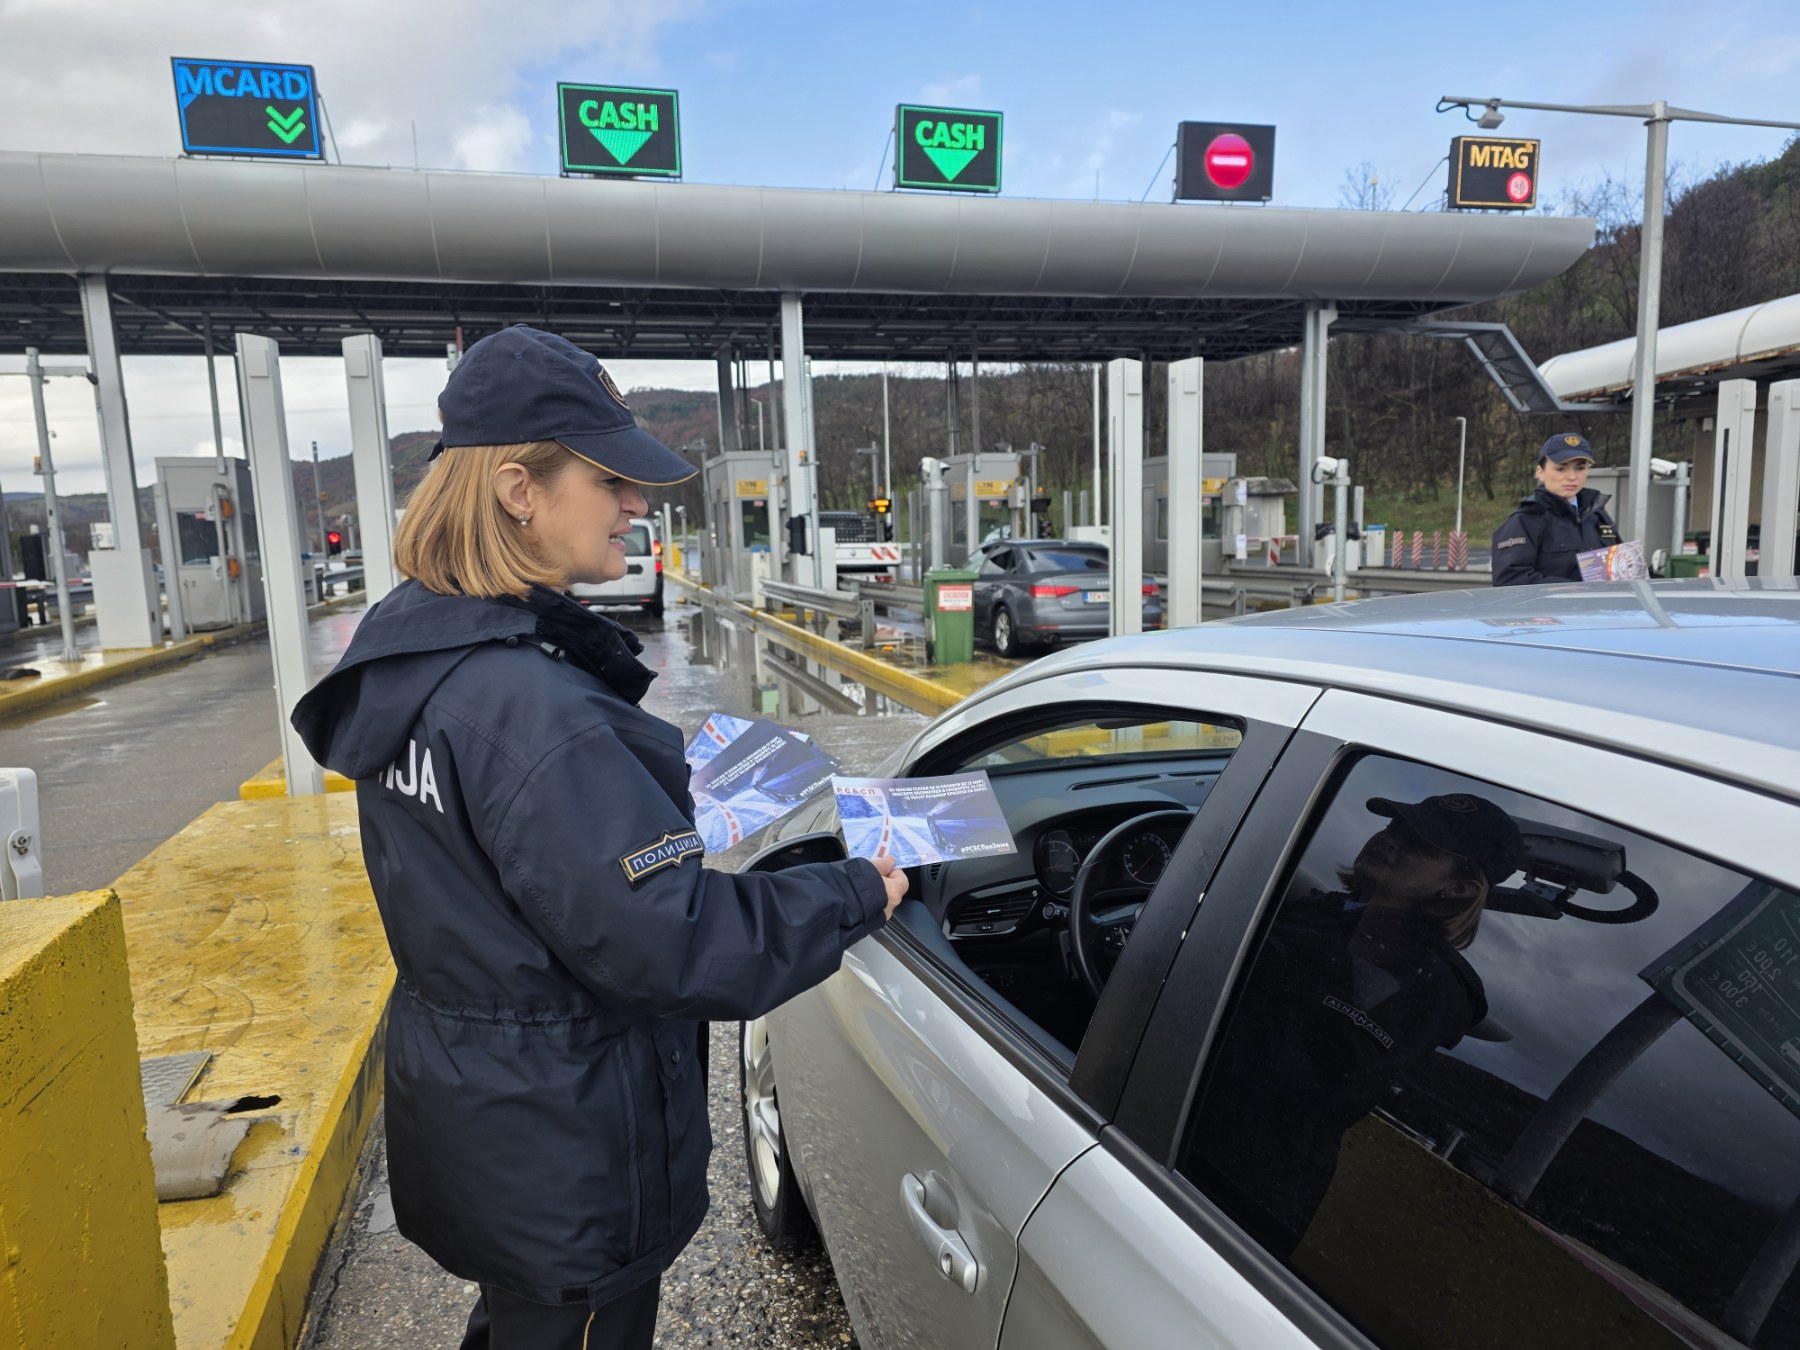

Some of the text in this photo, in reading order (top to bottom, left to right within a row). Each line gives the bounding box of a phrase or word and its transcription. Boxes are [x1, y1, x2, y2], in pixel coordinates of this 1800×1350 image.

[177, 65, 308, 101] MCARD
[579, 99, 659, 131] CASH
[915, 120, 985, 150] CASH
[1469, 144, 1529, 169] MTAG
[632, 836, 699, 871] ПОЛИЦИЈА
